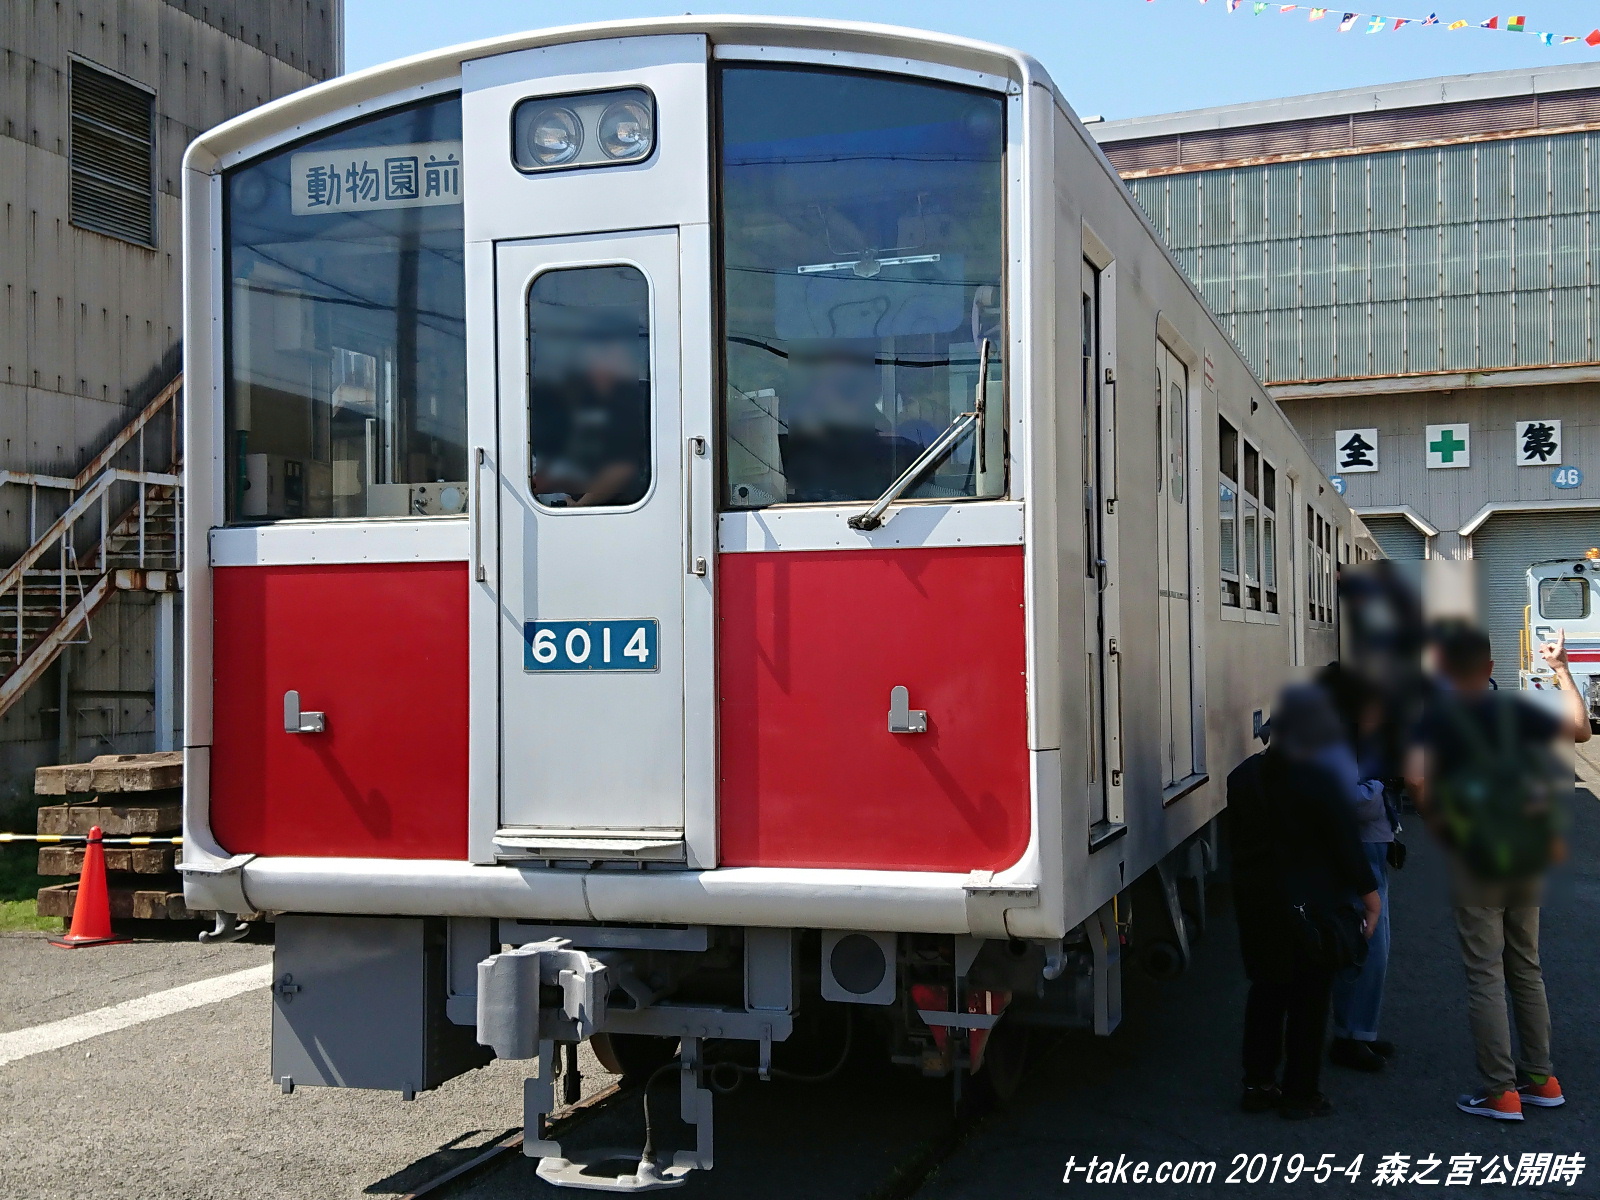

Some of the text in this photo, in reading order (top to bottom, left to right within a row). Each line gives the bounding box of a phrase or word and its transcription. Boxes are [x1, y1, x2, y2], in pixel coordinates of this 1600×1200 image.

[306, 153, 460, 207] 動物園前
[1339, 422, 1558, 468] 全 第
[1555, 469, 1579, 485] 46
[532, 627, 649, 663] 6014
